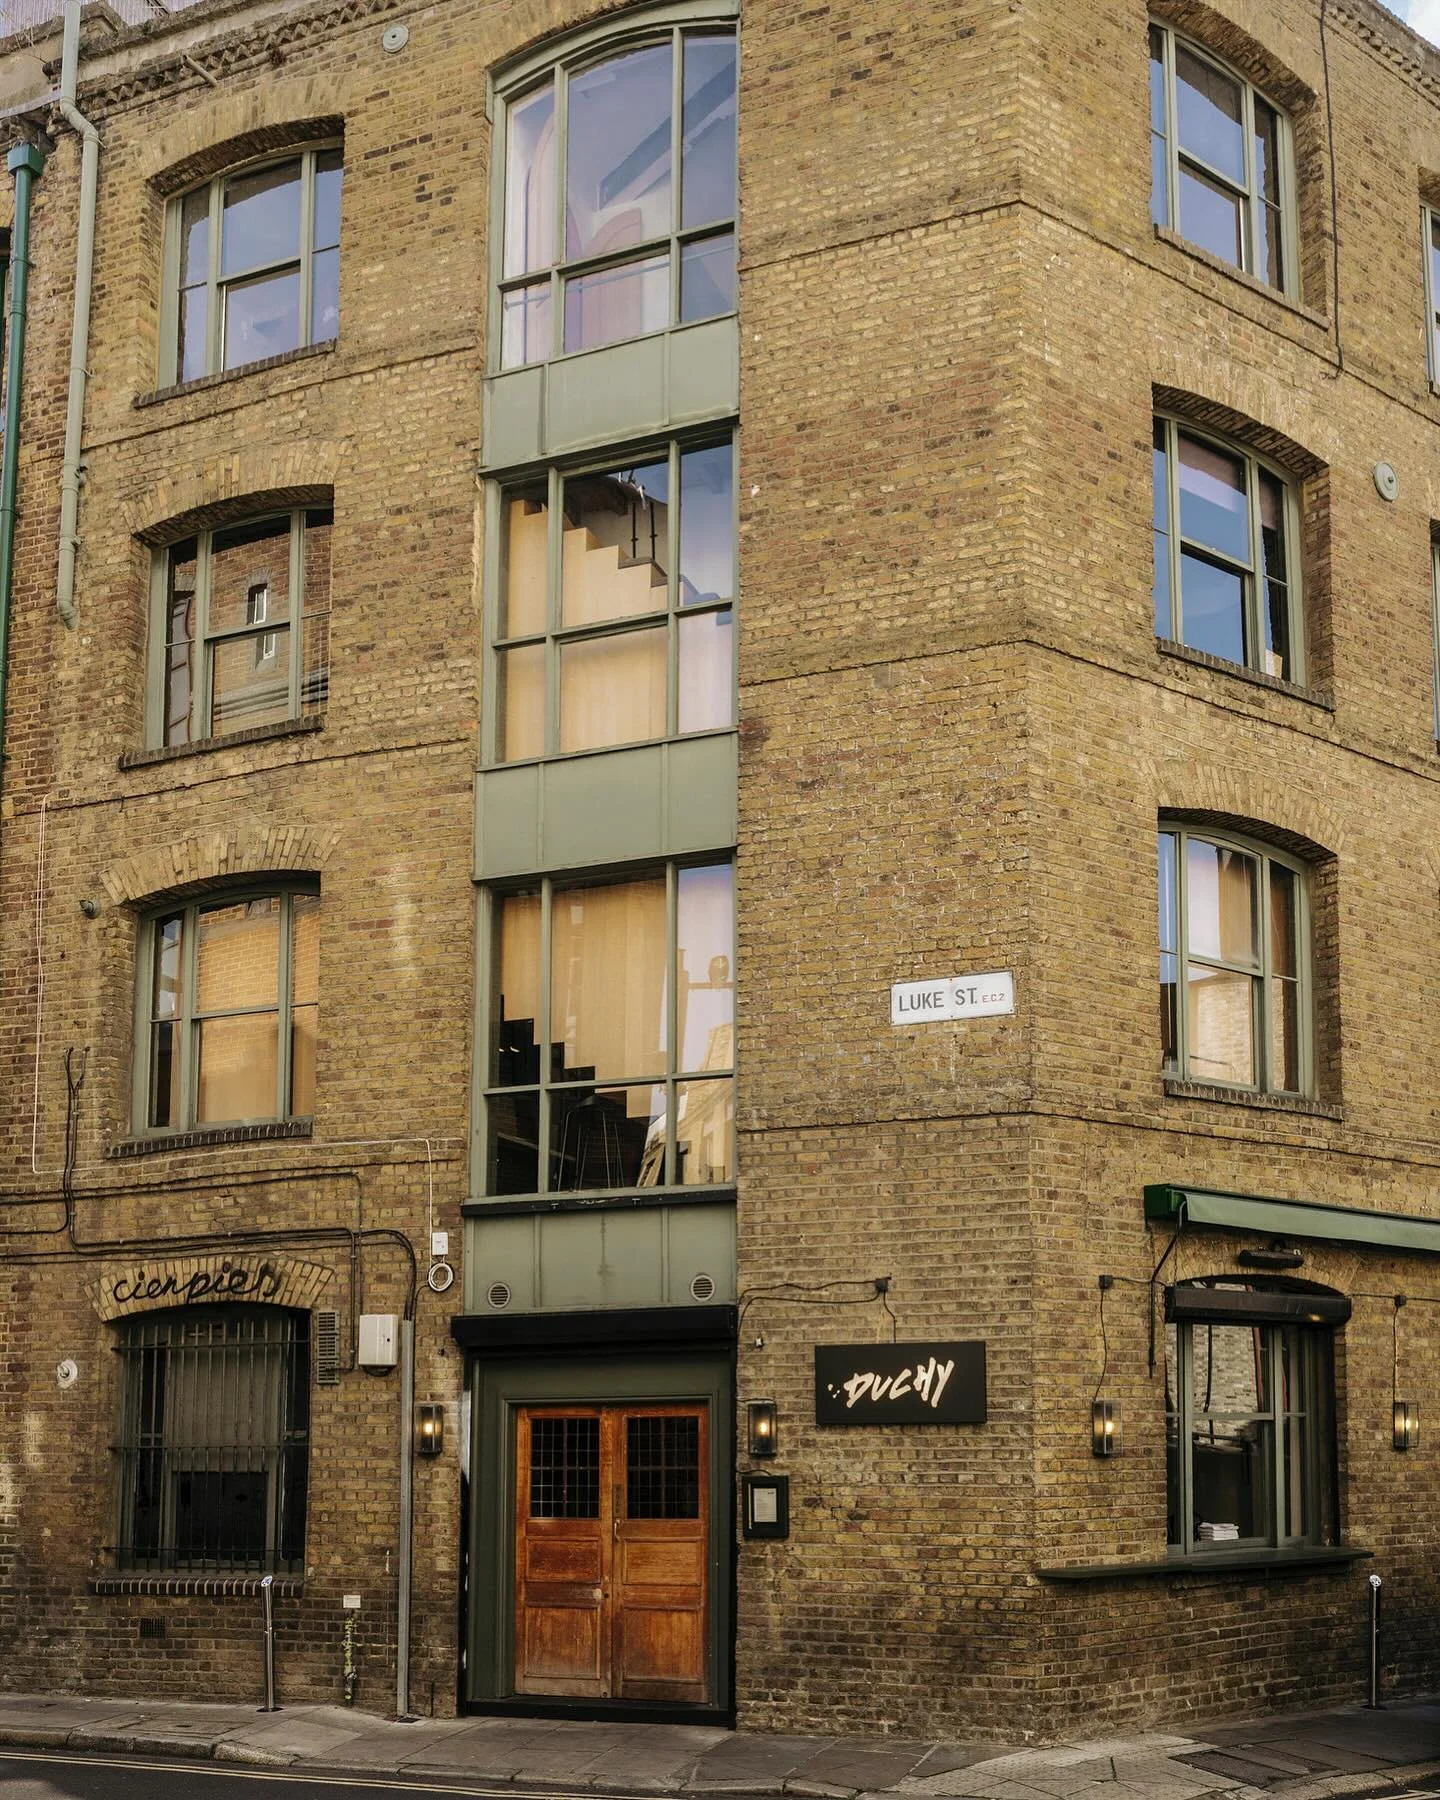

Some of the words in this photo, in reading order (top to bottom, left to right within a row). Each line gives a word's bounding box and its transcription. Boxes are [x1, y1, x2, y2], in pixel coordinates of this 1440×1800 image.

[899, 991, 944, 1012] LUKE
[954, 988, 978, 1005] ST.
[982, 993, 1005, 1003] EC2
[843, 1357, 955, 1408] DUCHY
